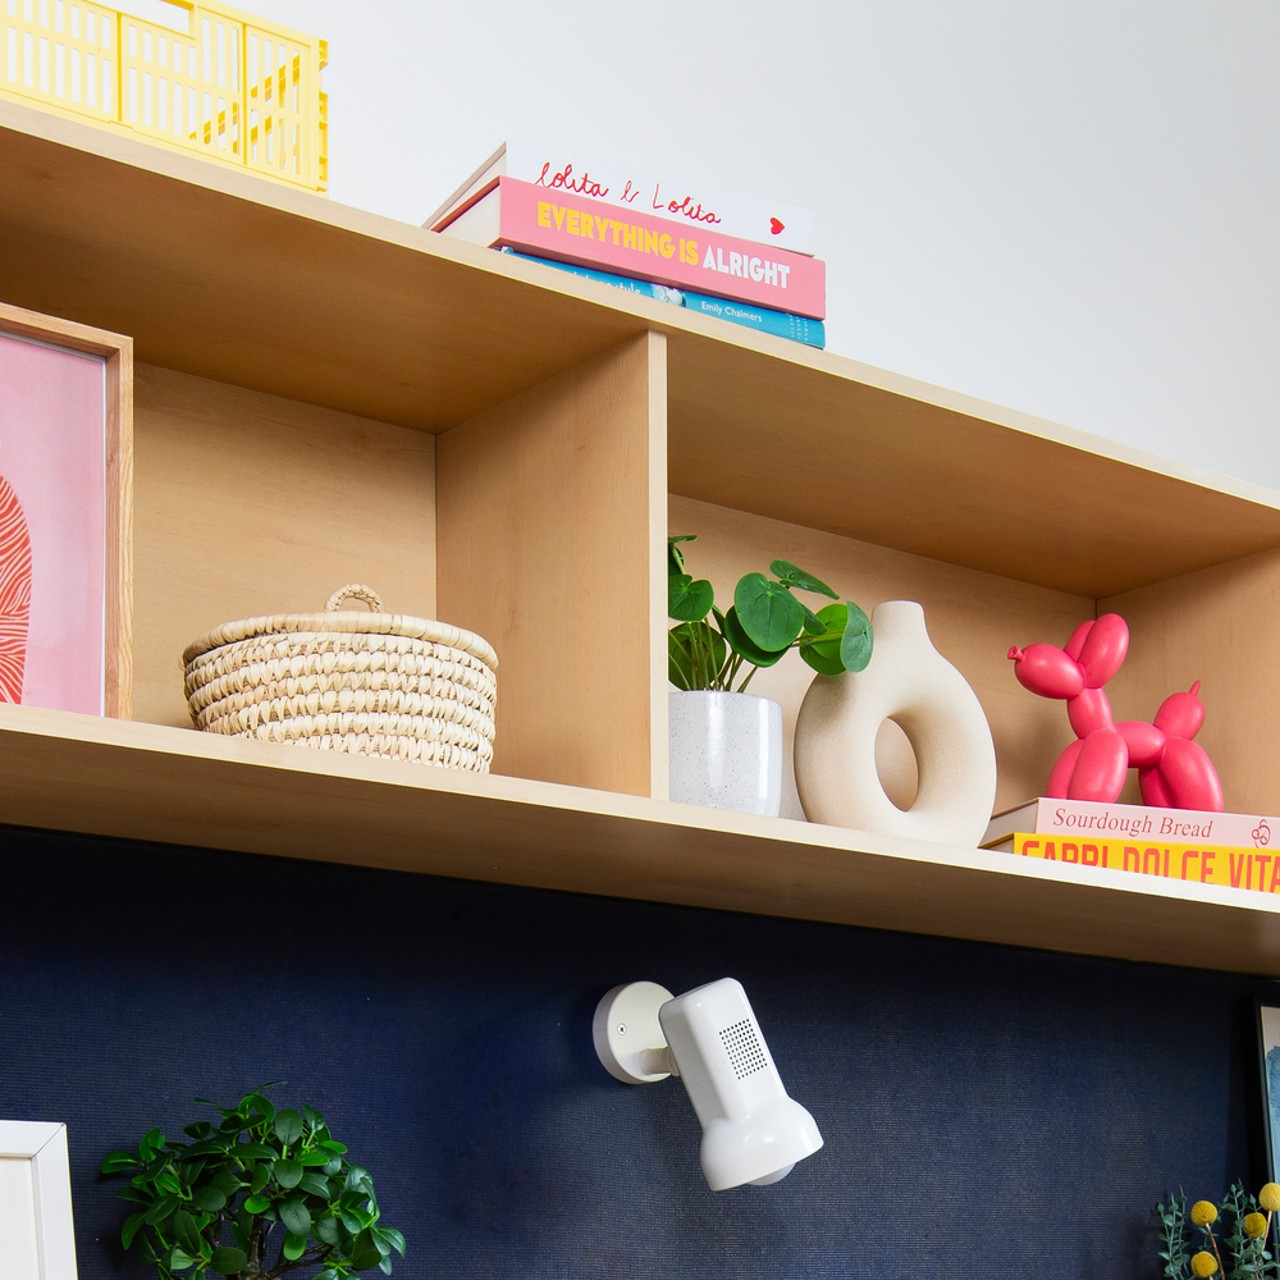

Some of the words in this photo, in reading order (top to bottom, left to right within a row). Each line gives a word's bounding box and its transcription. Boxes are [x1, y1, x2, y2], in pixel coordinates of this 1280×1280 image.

[537, 201, 676, 259] EVERYTHING
[679, 239, 700, 265] IS
[702, 244, 791, 289] ALRIGHT
[701, 300, 723, 315] Emily
[724, 306, 763, 323] Chalmers
[1053, 807, 1152, 838] Sourdough
[1159, 815, 1213, 838] Bread
